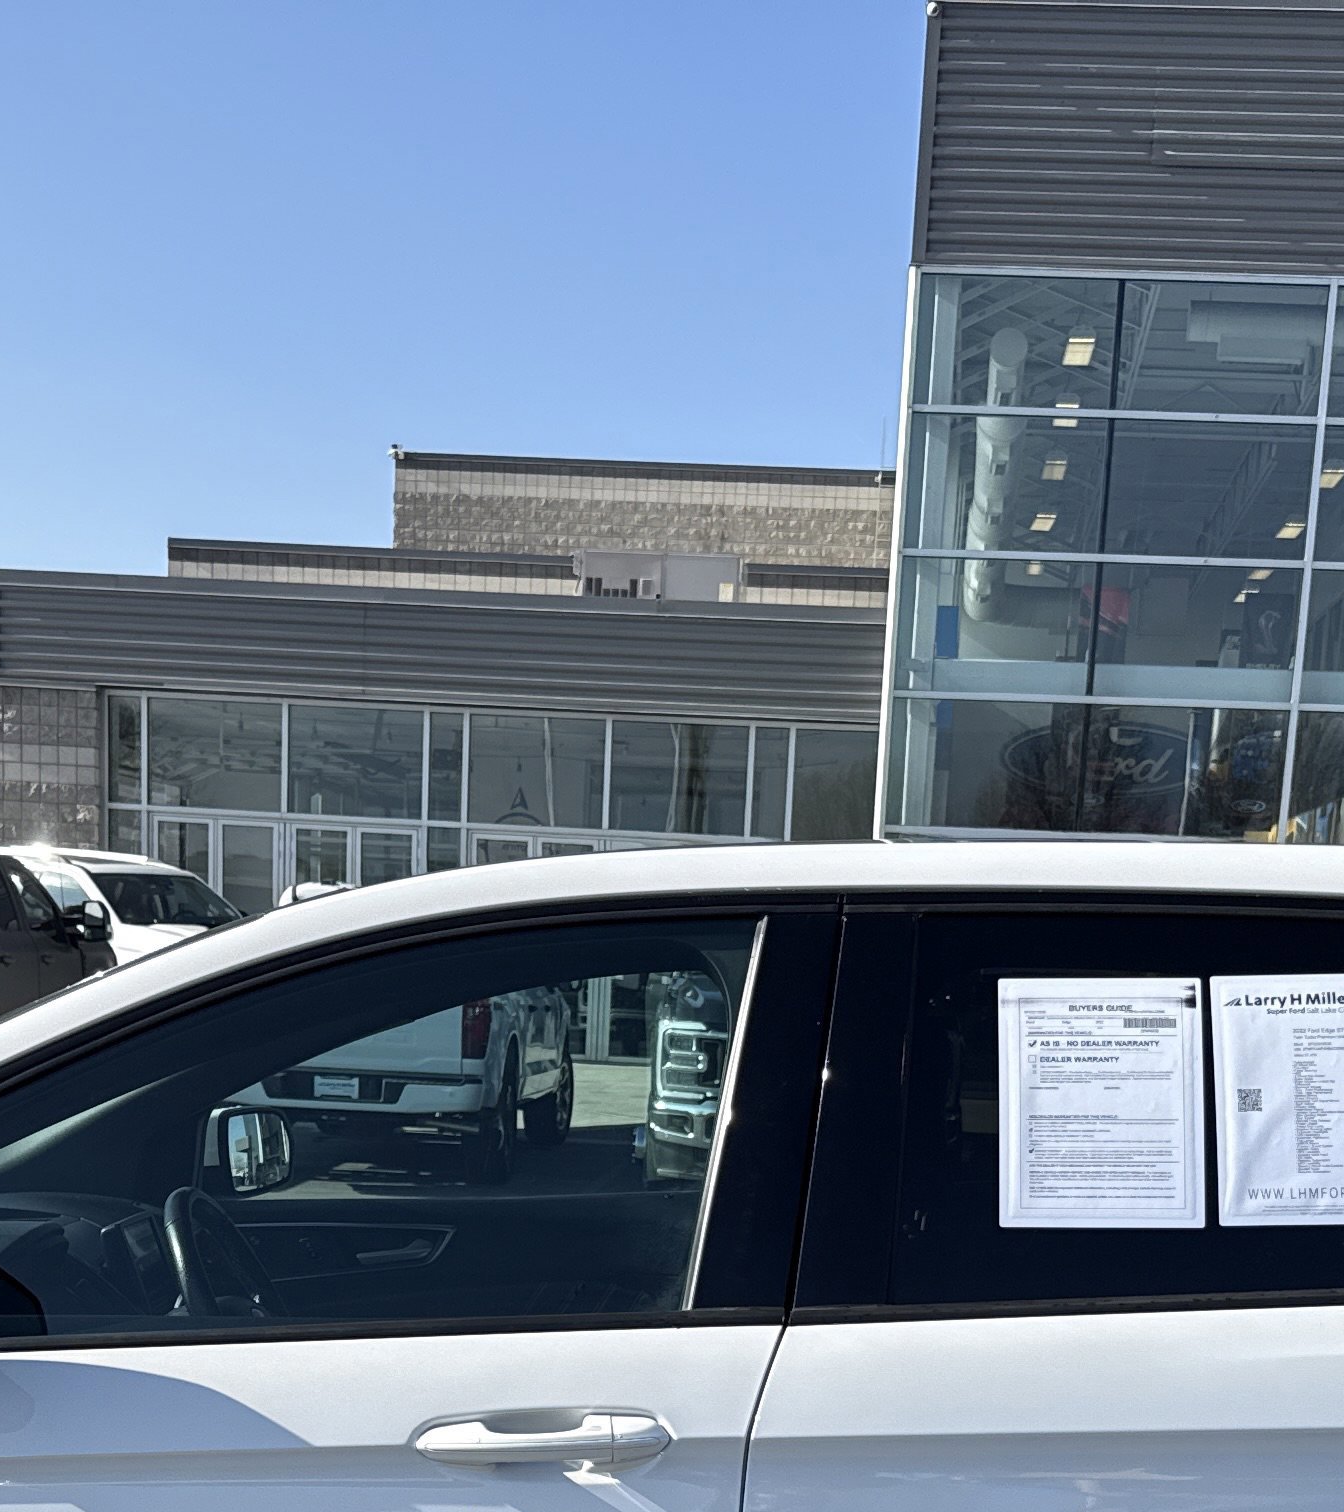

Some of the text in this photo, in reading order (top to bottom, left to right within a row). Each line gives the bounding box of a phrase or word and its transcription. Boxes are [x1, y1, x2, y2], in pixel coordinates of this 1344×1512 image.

[1245, 994, 1287, 1008] Larry
[1290, 993, 1301, 1005] H
[1068, 1004, 1104, 1012] BUYERS
[1106, 1004, 1133, 1012] GUIDE
